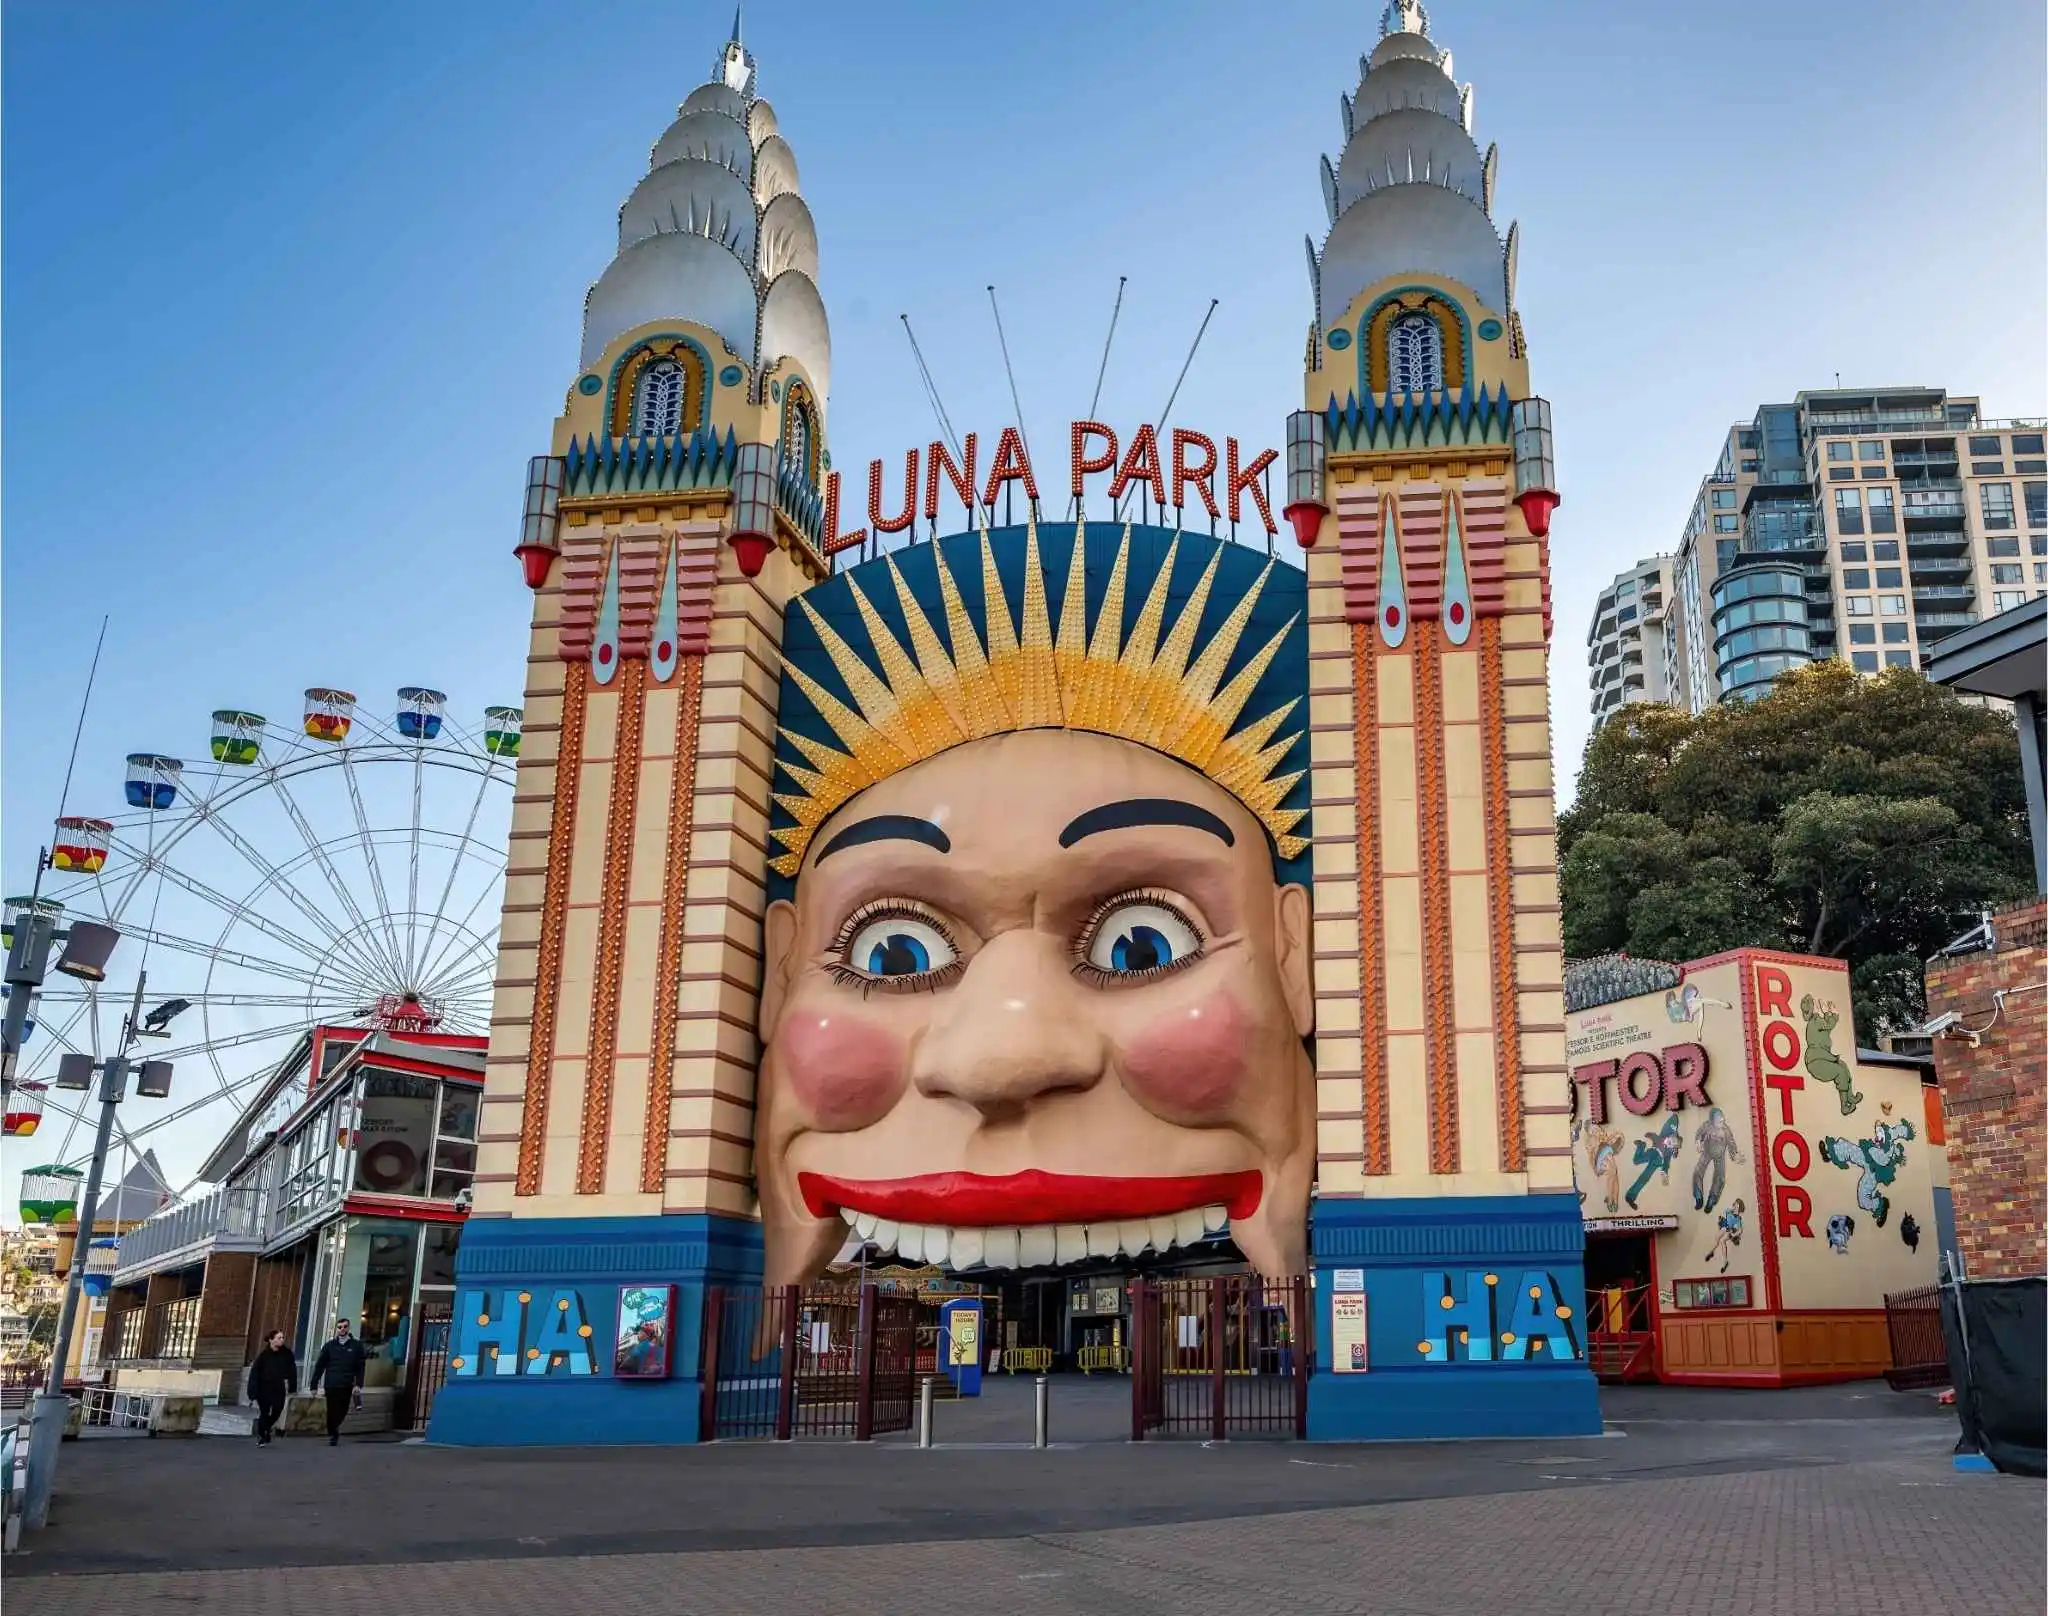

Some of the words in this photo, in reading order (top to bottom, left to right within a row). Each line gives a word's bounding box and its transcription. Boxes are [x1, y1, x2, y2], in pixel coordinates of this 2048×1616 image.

[823, 427, 1040, 555] LUNA
[1072, 420, 1279, 535] PARK
[1569, 1042, 1713, 1125] TOR
[1592, 1038, 1624, 1051] SCIENTIFIC
[1626, 1031, 1652, 1045] THEATRE
[1756, 966, 1815, 1237] ROTOR
[1611, 1218, 1665, 1228] THRILLING
[452, 1288, 599, 1377] HA
[1417, 1270, 1584, 1362] HA
